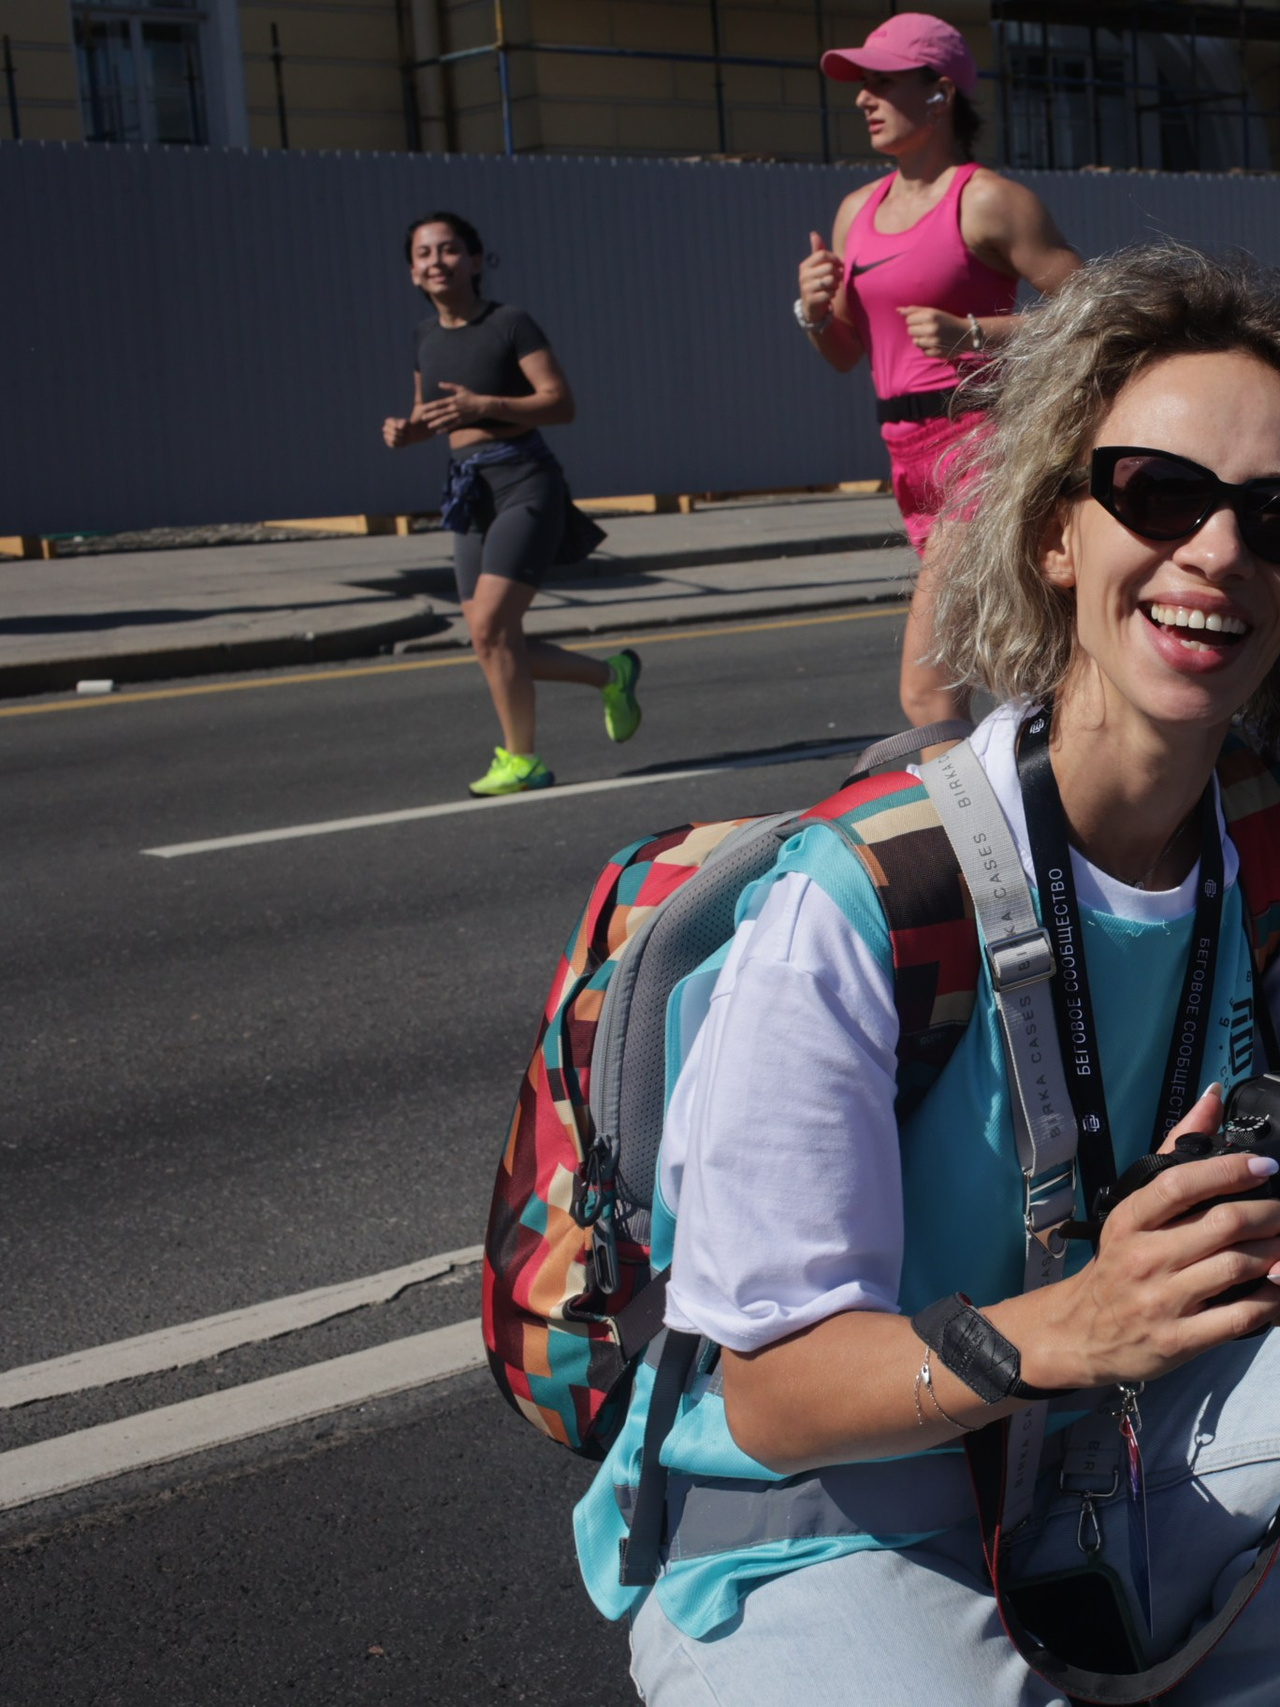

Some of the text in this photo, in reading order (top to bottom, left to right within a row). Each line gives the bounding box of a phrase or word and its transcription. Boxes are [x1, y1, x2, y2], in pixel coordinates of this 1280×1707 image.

[942, 760, 973, 808] BIRKA
[974, 832, 1007, 899] CASES
[1049, 868, 1092, 1076] БЕГОВОЕ СООБЩЕСТВО
[1186, 937, 1211, 1016] БЕГОВОЕ
[1020, 995, 1062, 1138] BIRKA CASES
